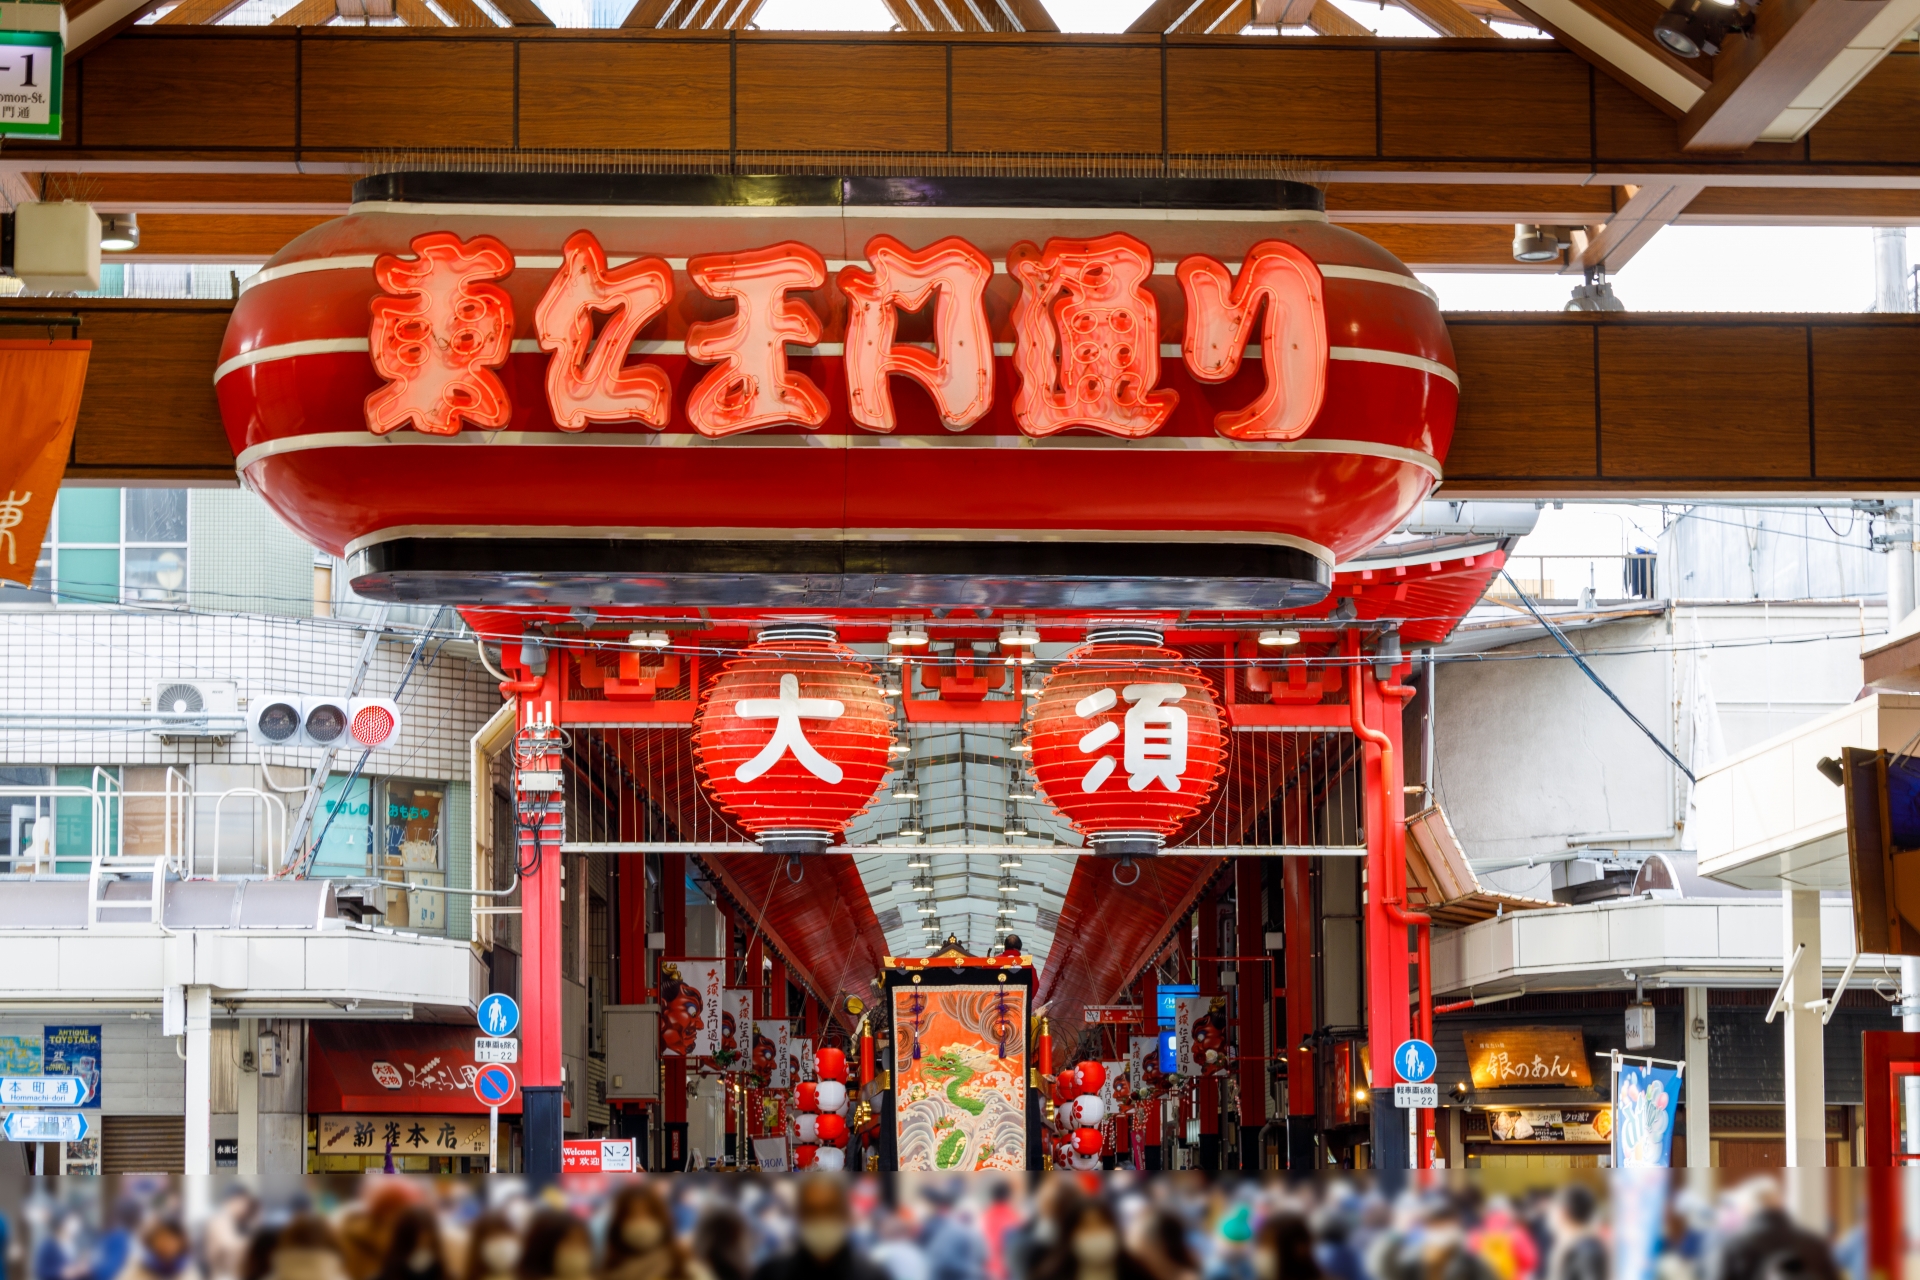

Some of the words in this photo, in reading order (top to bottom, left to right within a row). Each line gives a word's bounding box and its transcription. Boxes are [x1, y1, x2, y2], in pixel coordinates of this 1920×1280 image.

[2, 105, 30, 119] 門通
[388, 804, 430, 819] おもちゃ
[49, 1035, 97, 1044] TOYSTALK
[477, 1040, 516, 1050] 軽車両を除く
[6, 1060, 39, 1072] トーク
[374, 1065, 396, 1074] 大須
[1486, 1051, 1570, 1080] 銀のあん
[379, 1076, 401, 1085] 名物
[9, 1081, 69, 1095] 本町通
[1397, 1086, 1436, 1095] 軽車両を除く
[563, 1147, 597, 1156] Welcome
[604, 1146, 630, 1157] N-2
[580, 1157, 600, 1166] 欢迎
